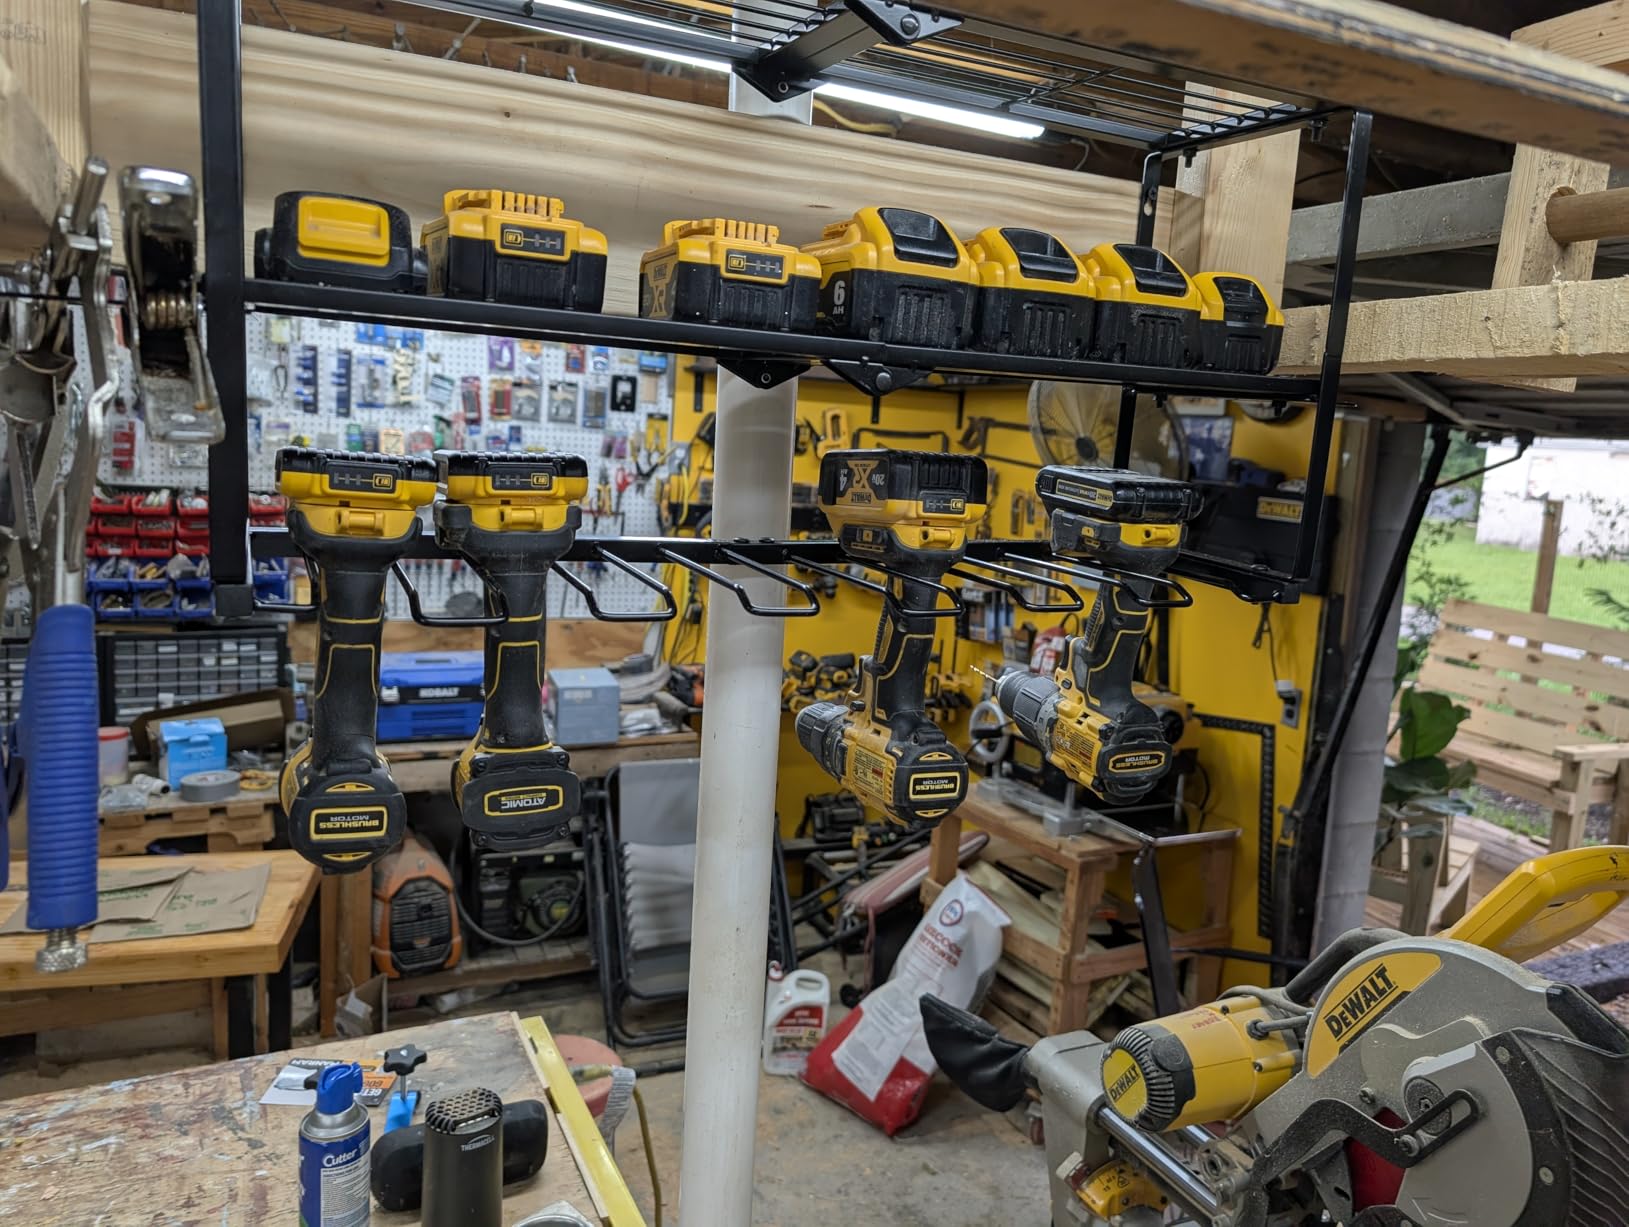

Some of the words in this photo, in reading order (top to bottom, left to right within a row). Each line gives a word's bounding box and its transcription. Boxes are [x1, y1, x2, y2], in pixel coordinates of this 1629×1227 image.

[833, 280, 846, 305] 6
[839, 475, 848, 491] 4
[419, 687, 459, 698] KOBALT
[1116, 758, 1158, 768] BRUSHLESS
[1125, 755, 1150, 763] MOTOR
[915, 782, 955, 791] BRUSHLESS
[500, 797, 546, 809] ATOMIC
[330, 814, 369, 822] MOTOR
[319, 819, 380, 829] BRUSHLESS
[1324, 965, 1394, 1040] DEWALT
[460, 1135, 496, 1152] THERMACELL
[322, 1148, 358, 1168] Cutter
